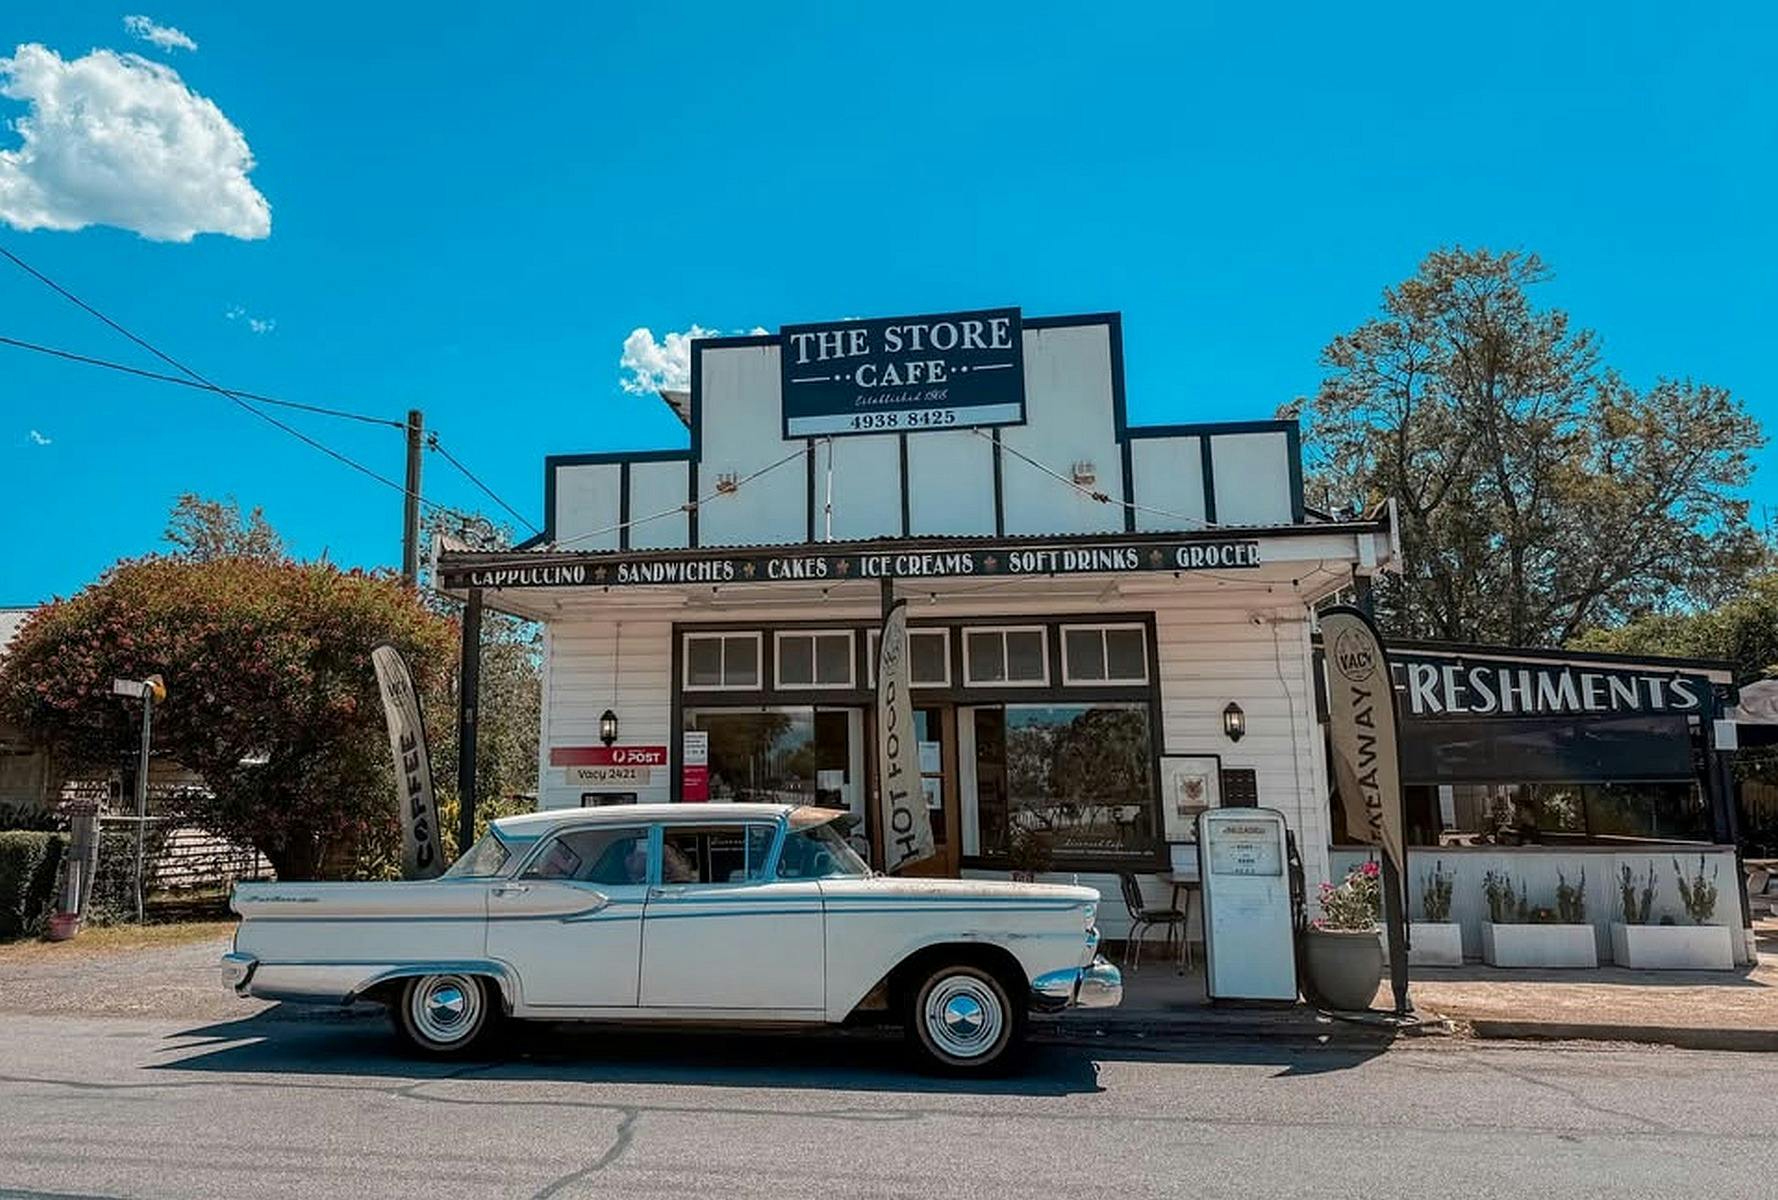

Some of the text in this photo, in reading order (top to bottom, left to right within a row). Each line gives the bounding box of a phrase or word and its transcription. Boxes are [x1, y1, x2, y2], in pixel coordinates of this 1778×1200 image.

[790, 318, 1013, 364] THE STORE
[855, 360, 948, 388] CAFE
[851, 410, 955, 430] 4938 8425
[471, 544, 1260, 586] CAPPUCCINO SANDWICHES CAKES ICE CREAMS SOFT DRINKS GROCER
[886, 681, 902, 779] FOOD
[577, 768, 636, 781] Vacy 2421
[628, 751, 661, 764] POST
[400, 731, 434, 868] COFFEE
[889, 790, 919, 863] HOT
